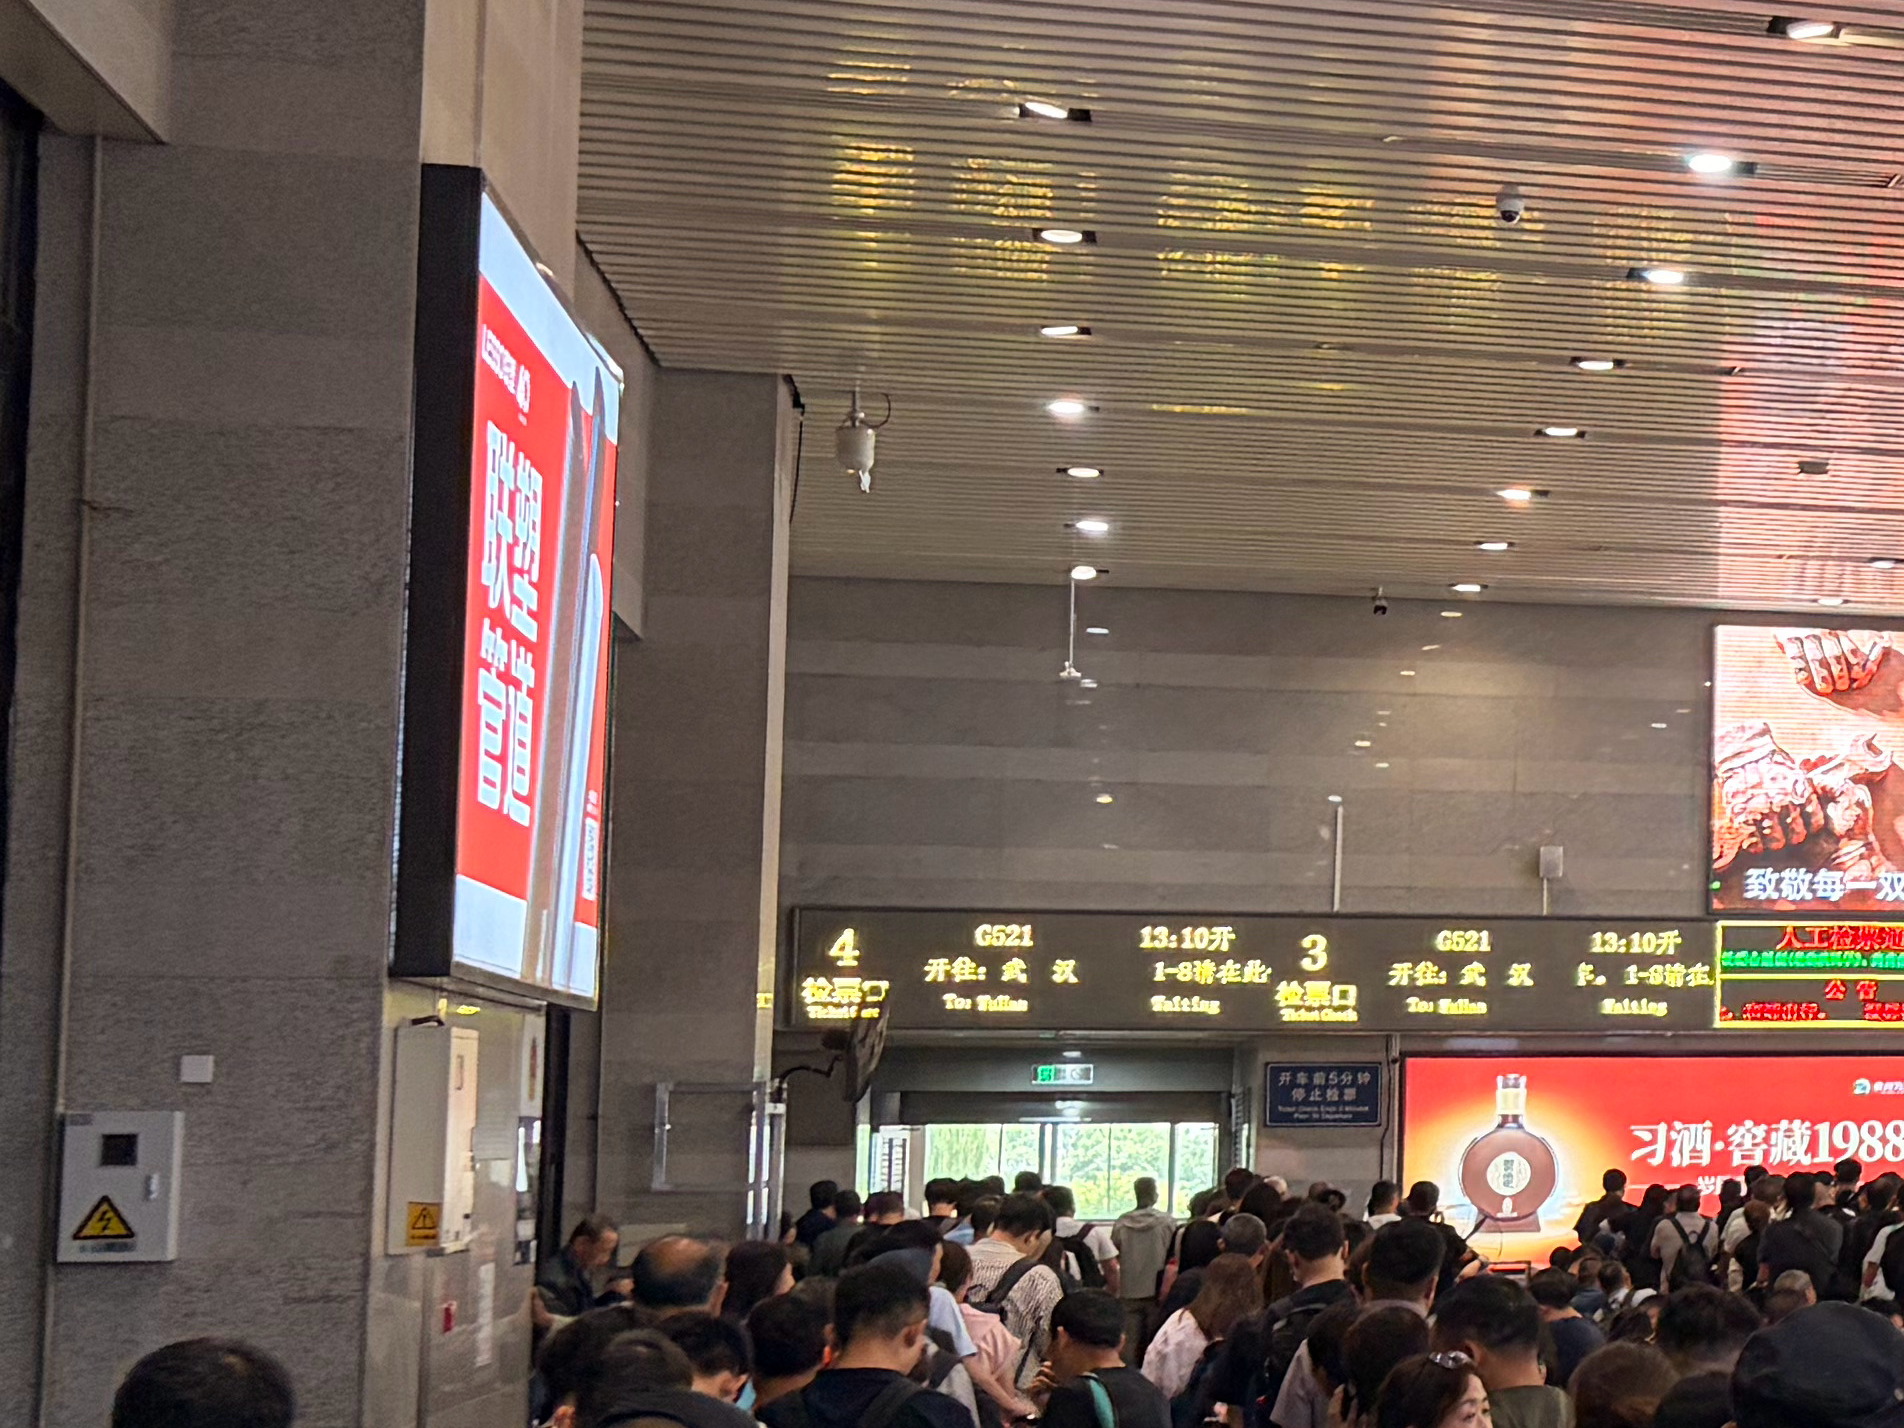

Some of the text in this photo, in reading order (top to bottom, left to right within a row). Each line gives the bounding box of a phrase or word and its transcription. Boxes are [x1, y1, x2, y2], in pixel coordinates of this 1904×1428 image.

[480, 419, 543, 643] 联塑
[477, 617, 534, 828] 管道
[829, 928, 860, 966] 4
[975, 924, 1034, 947] G521
[1139, 925, 1236, 952] 13:10开
[1436, 930, 1492, 952] G521
[1591, 930, 1682, 955] 13:10开
[1300, 934, 1328, 972] 3
[802, 977, 889, 1004] 检票口
[1275, 980, 1358, 1007] 检票口
[1824, 979, 1878, 1000] 公告
[1279, 1071, 1371, 1086] 开车前5分钟
